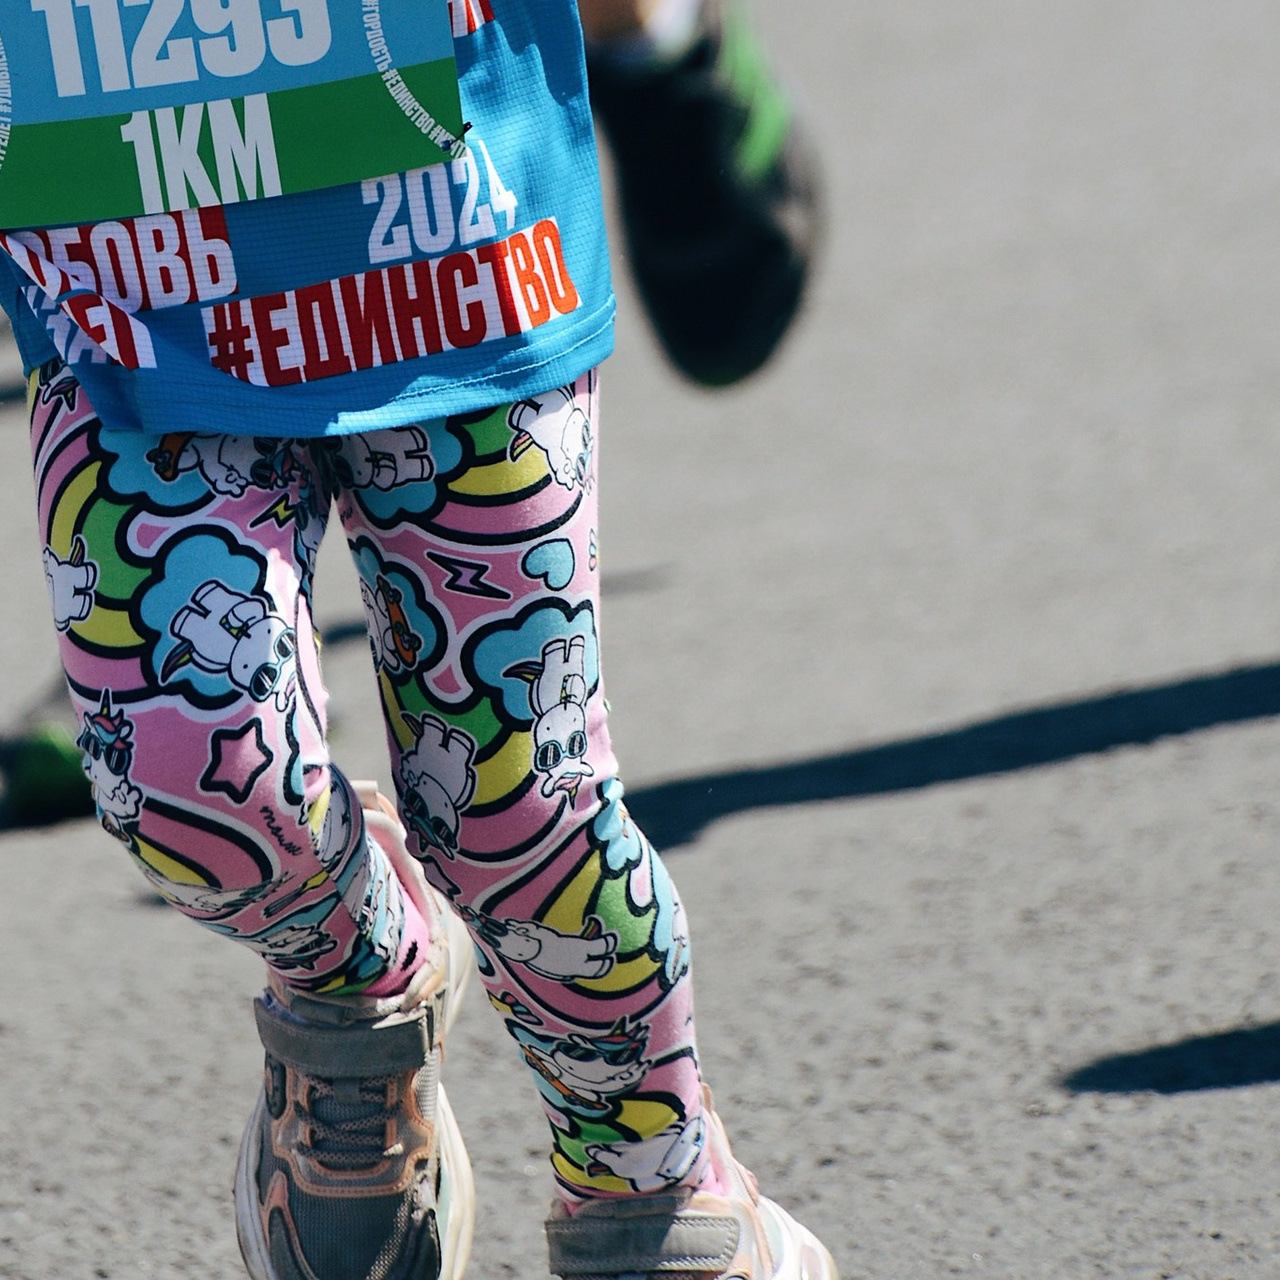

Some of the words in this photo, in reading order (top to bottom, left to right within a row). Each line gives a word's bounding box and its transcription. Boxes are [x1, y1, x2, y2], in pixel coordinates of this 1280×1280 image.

[380, 67, 436, 135] #ЕДИНСТВО
[361, 138, 518, 264] 2024
[209, 218, 582, 387] #ЕДИНСТВО
